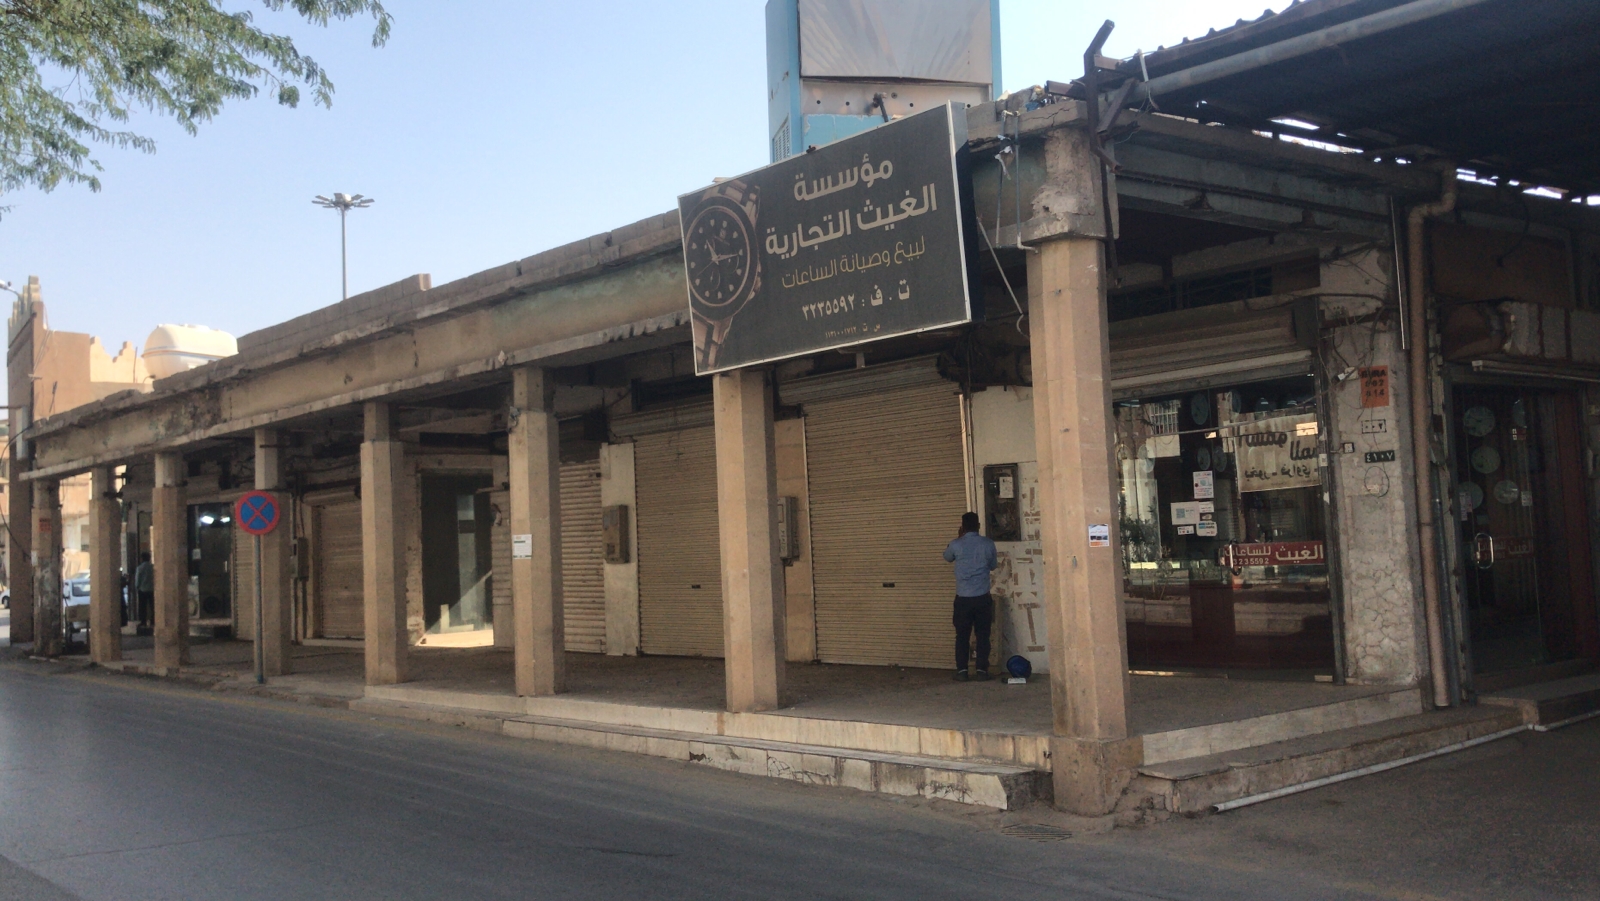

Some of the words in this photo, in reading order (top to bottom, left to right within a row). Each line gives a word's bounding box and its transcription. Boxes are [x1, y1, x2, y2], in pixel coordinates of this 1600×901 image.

[793, 152, 893, 201] مؤسسة
[857, 183, 938, 230] الغيث
[765, 209, 851, 259] التجارية
[840, 250, 891, 274] وصيانة
[894, 236, 926, 264] لبيع
[781, 259, 838, 288] الساعات
[802, 294, 855, 321] ٣٢٣٥٥٩٢
[1233, 557, 1269, 565] 3235592
[1275, 544, 1324, 564] الغيث
